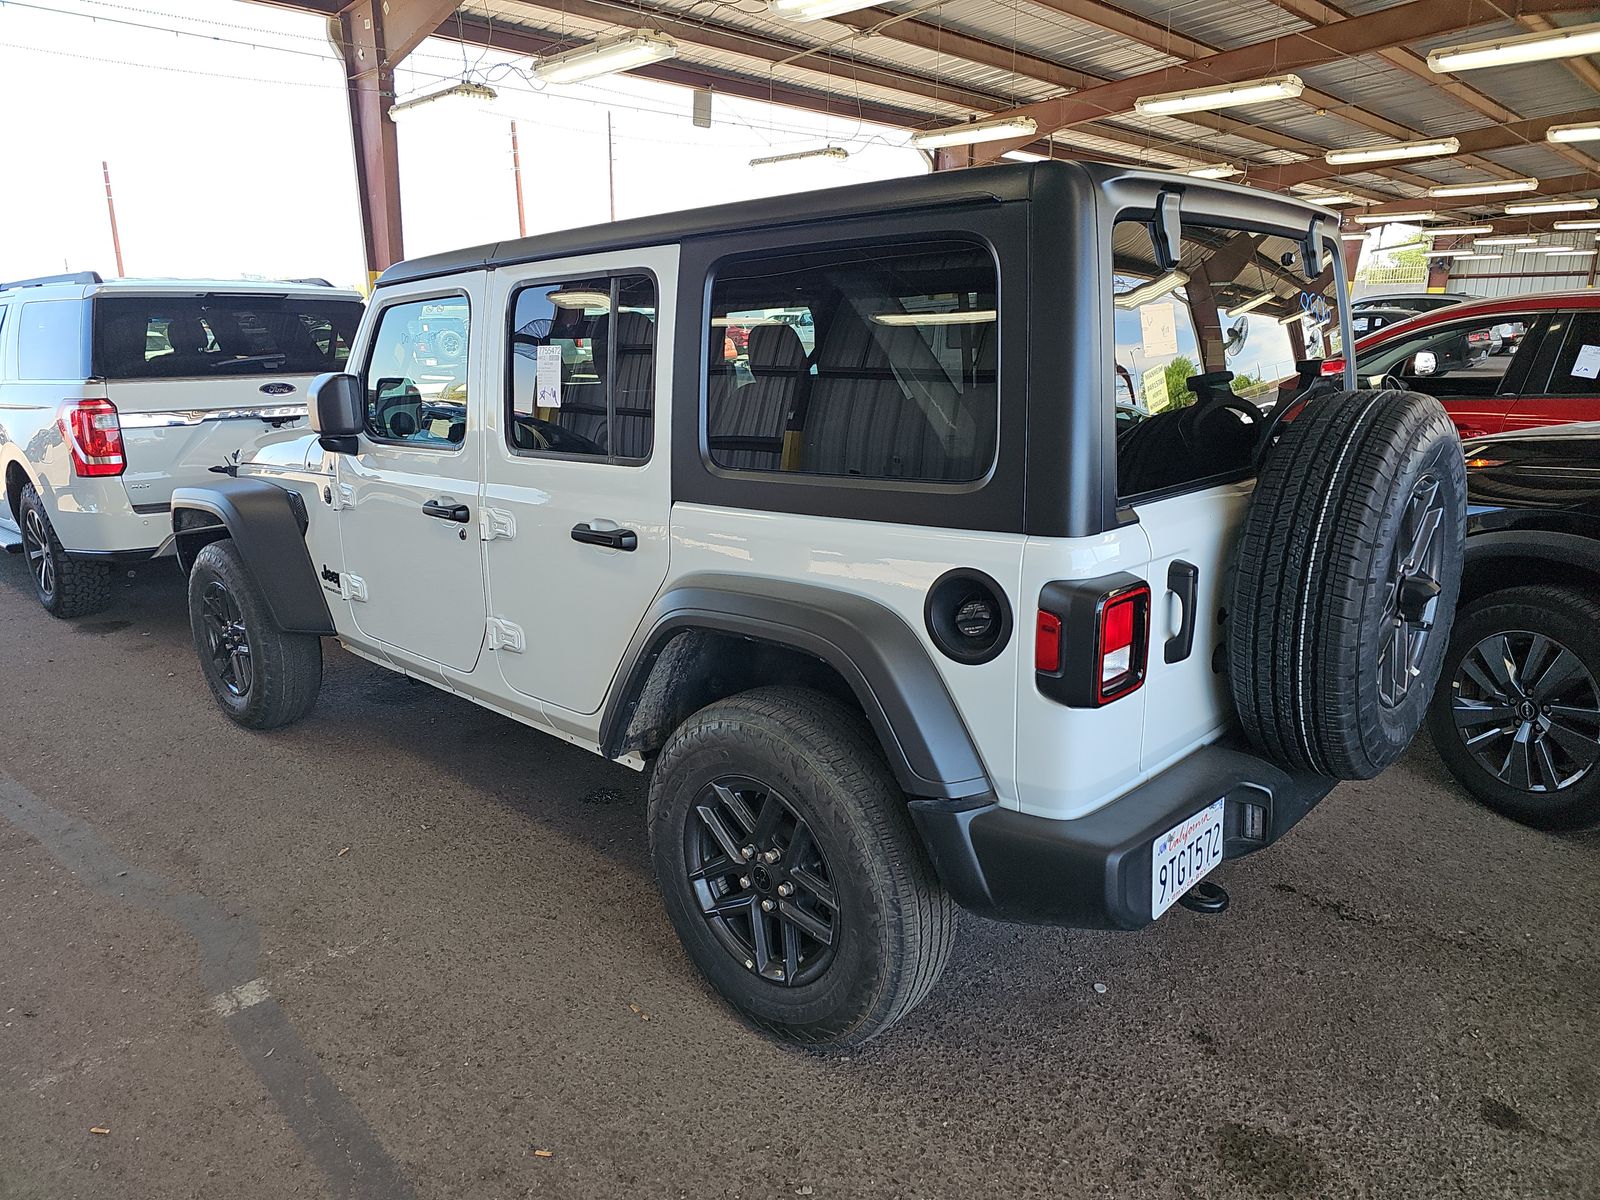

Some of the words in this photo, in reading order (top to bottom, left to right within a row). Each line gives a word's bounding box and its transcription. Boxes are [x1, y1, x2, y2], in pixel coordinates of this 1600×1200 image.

[268, 384, 290, 393] Ford
[1168, 813, 1212, 852] California
[1159, 822, 1220, 905] 9TGT572
